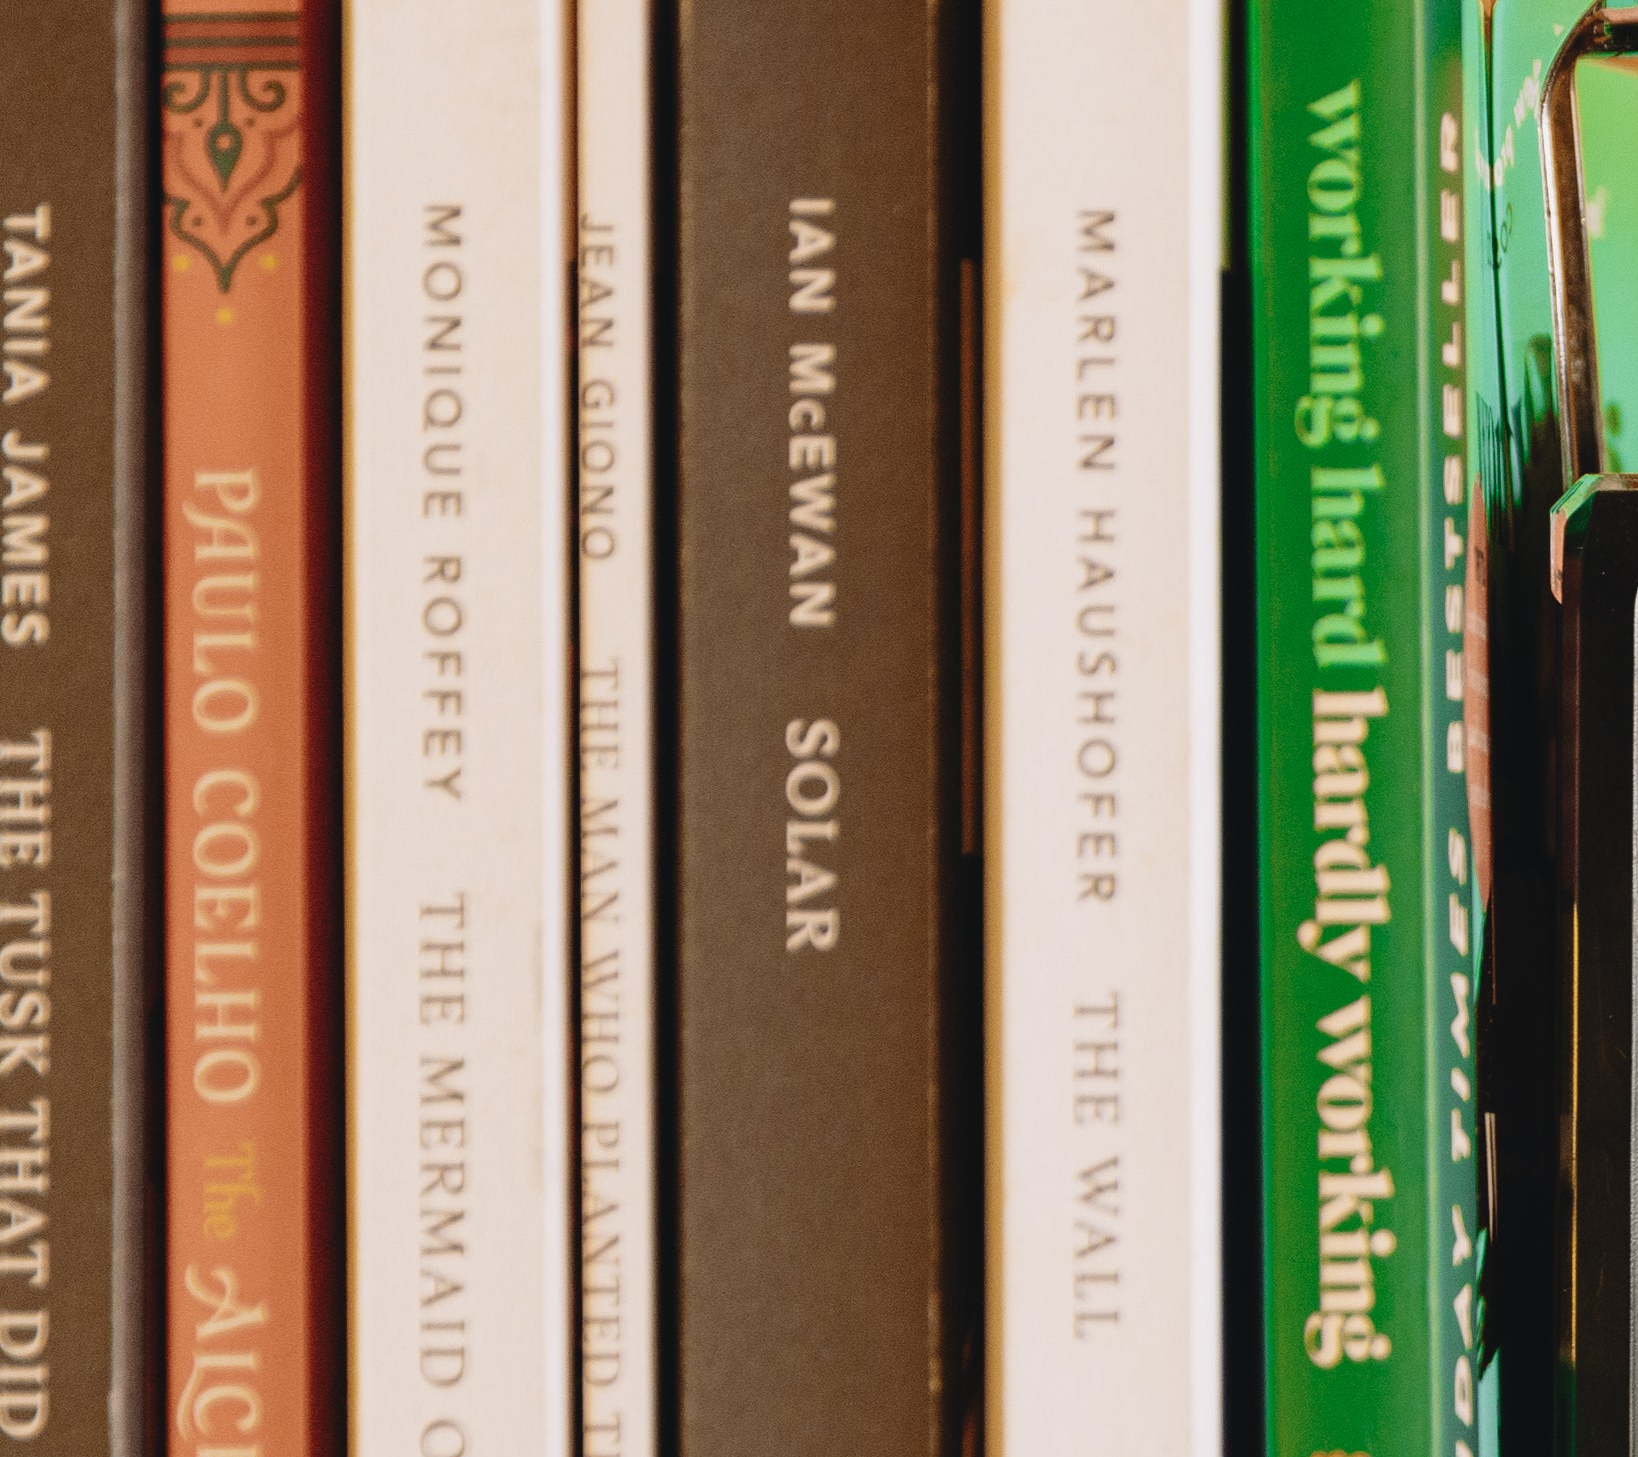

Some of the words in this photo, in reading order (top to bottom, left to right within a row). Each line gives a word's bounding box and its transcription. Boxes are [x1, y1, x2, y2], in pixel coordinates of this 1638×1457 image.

[3, 206, 49, 400] TANIA
[580, 213, 616, 348] JEAN
[790, 200, 833, 311] IAN
[1078, 210, 1117, 470] MARLEN
[1295, 80, 1384, 448] working
[423, 205, 463, 516] MONIQUE
[1439, 112, 1466, 774] BESTSELLER
[1, 432, 47, 644] JAMES
[581, 381, 616, 562] GIONO
[789, 345, 834, 624] McEWAN
[1309, 467, 1388, 669] hard
[183, 467, 262, 734] PAULO
[423, 556, 463, 799] ROFFEY
[0, 731, 50, 866] THE
[580, 656, 620, 771] THE
[1077, 510, 1118, 901] HAUSHOFER
[193, 769, 260, 1104] COELHO
[580, 793, 621, 920] MAN
[786, 720, 837, 949] SOLAR
[1297, 689, 1393, 984] hardly
[0, 893, 49, 1073] TUSK
[420, 893, 465, 1024] THE
[580, 949, 620, 1096] WHO
[1074, 992, 1120, 1124] THE
[1448, 826, 1472, 1163] TIMES
[0, 1100, 48, 1285] THAT
[203, 1140, 262, 1240] The
[421, 1058, 466, 1388] MERMAID
[580, 1120, 621, 1390] PLANTED
[1075, 1156, 1120, 1338] WALL
[1303, 993, 1398, 1369] working
[0, 1312, 47, 1437] DID
